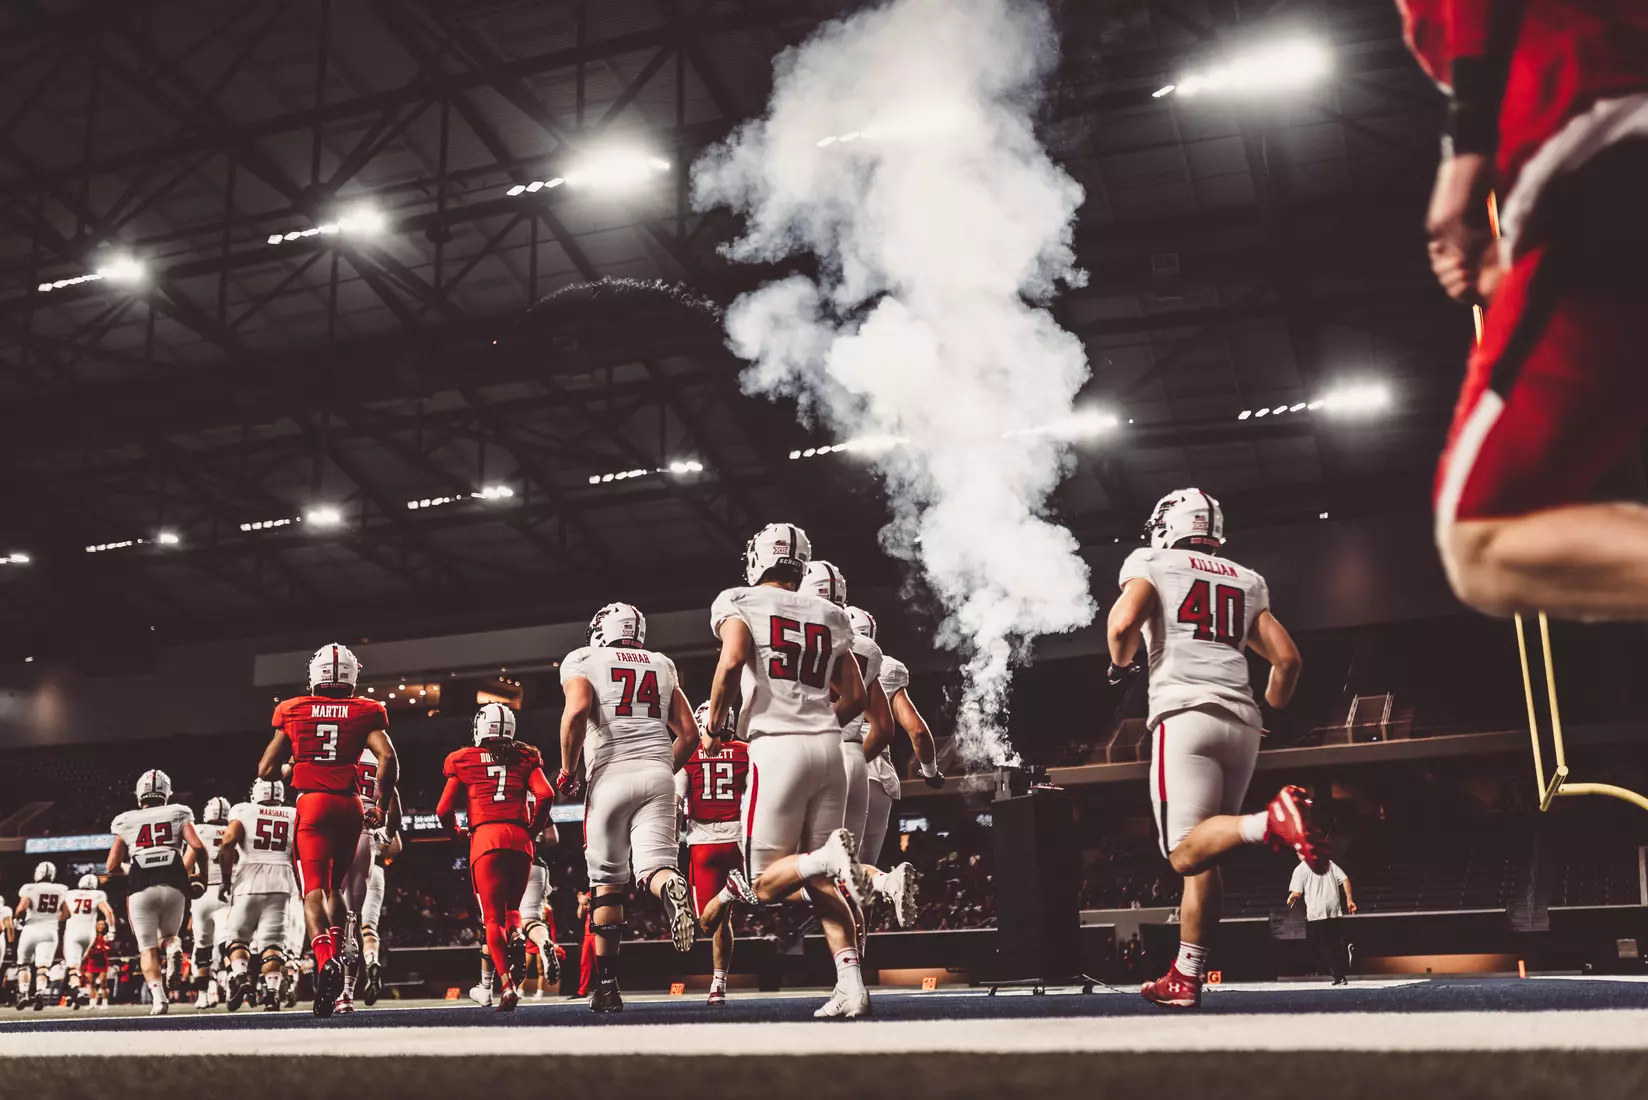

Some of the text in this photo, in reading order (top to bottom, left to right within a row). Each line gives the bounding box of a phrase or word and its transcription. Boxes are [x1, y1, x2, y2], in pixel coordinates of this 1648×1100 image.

[1188, 556, 1238, 577] KILLIAN
[1177, 579, 1245, 650] 40
[616, 652, 651, 664] FARRAR
[769, 615, 832, 689] 50
[611, 667, 661, 718] 74
[311, 705, 349, 718] MARTIN
[313, 722, 340, 762] 3
[486, 765, 507, 801] 7
[701, 762, 734, 800] 12
[259, 808, 289, 818] MARSHALL
[136, 821, 172, 848] 42
[253, 818, 289, 852] 59
[37, 894, 59, 913] 69
[74, 899, 92, 914] 79
[1209, 972, 1220, 983] G
